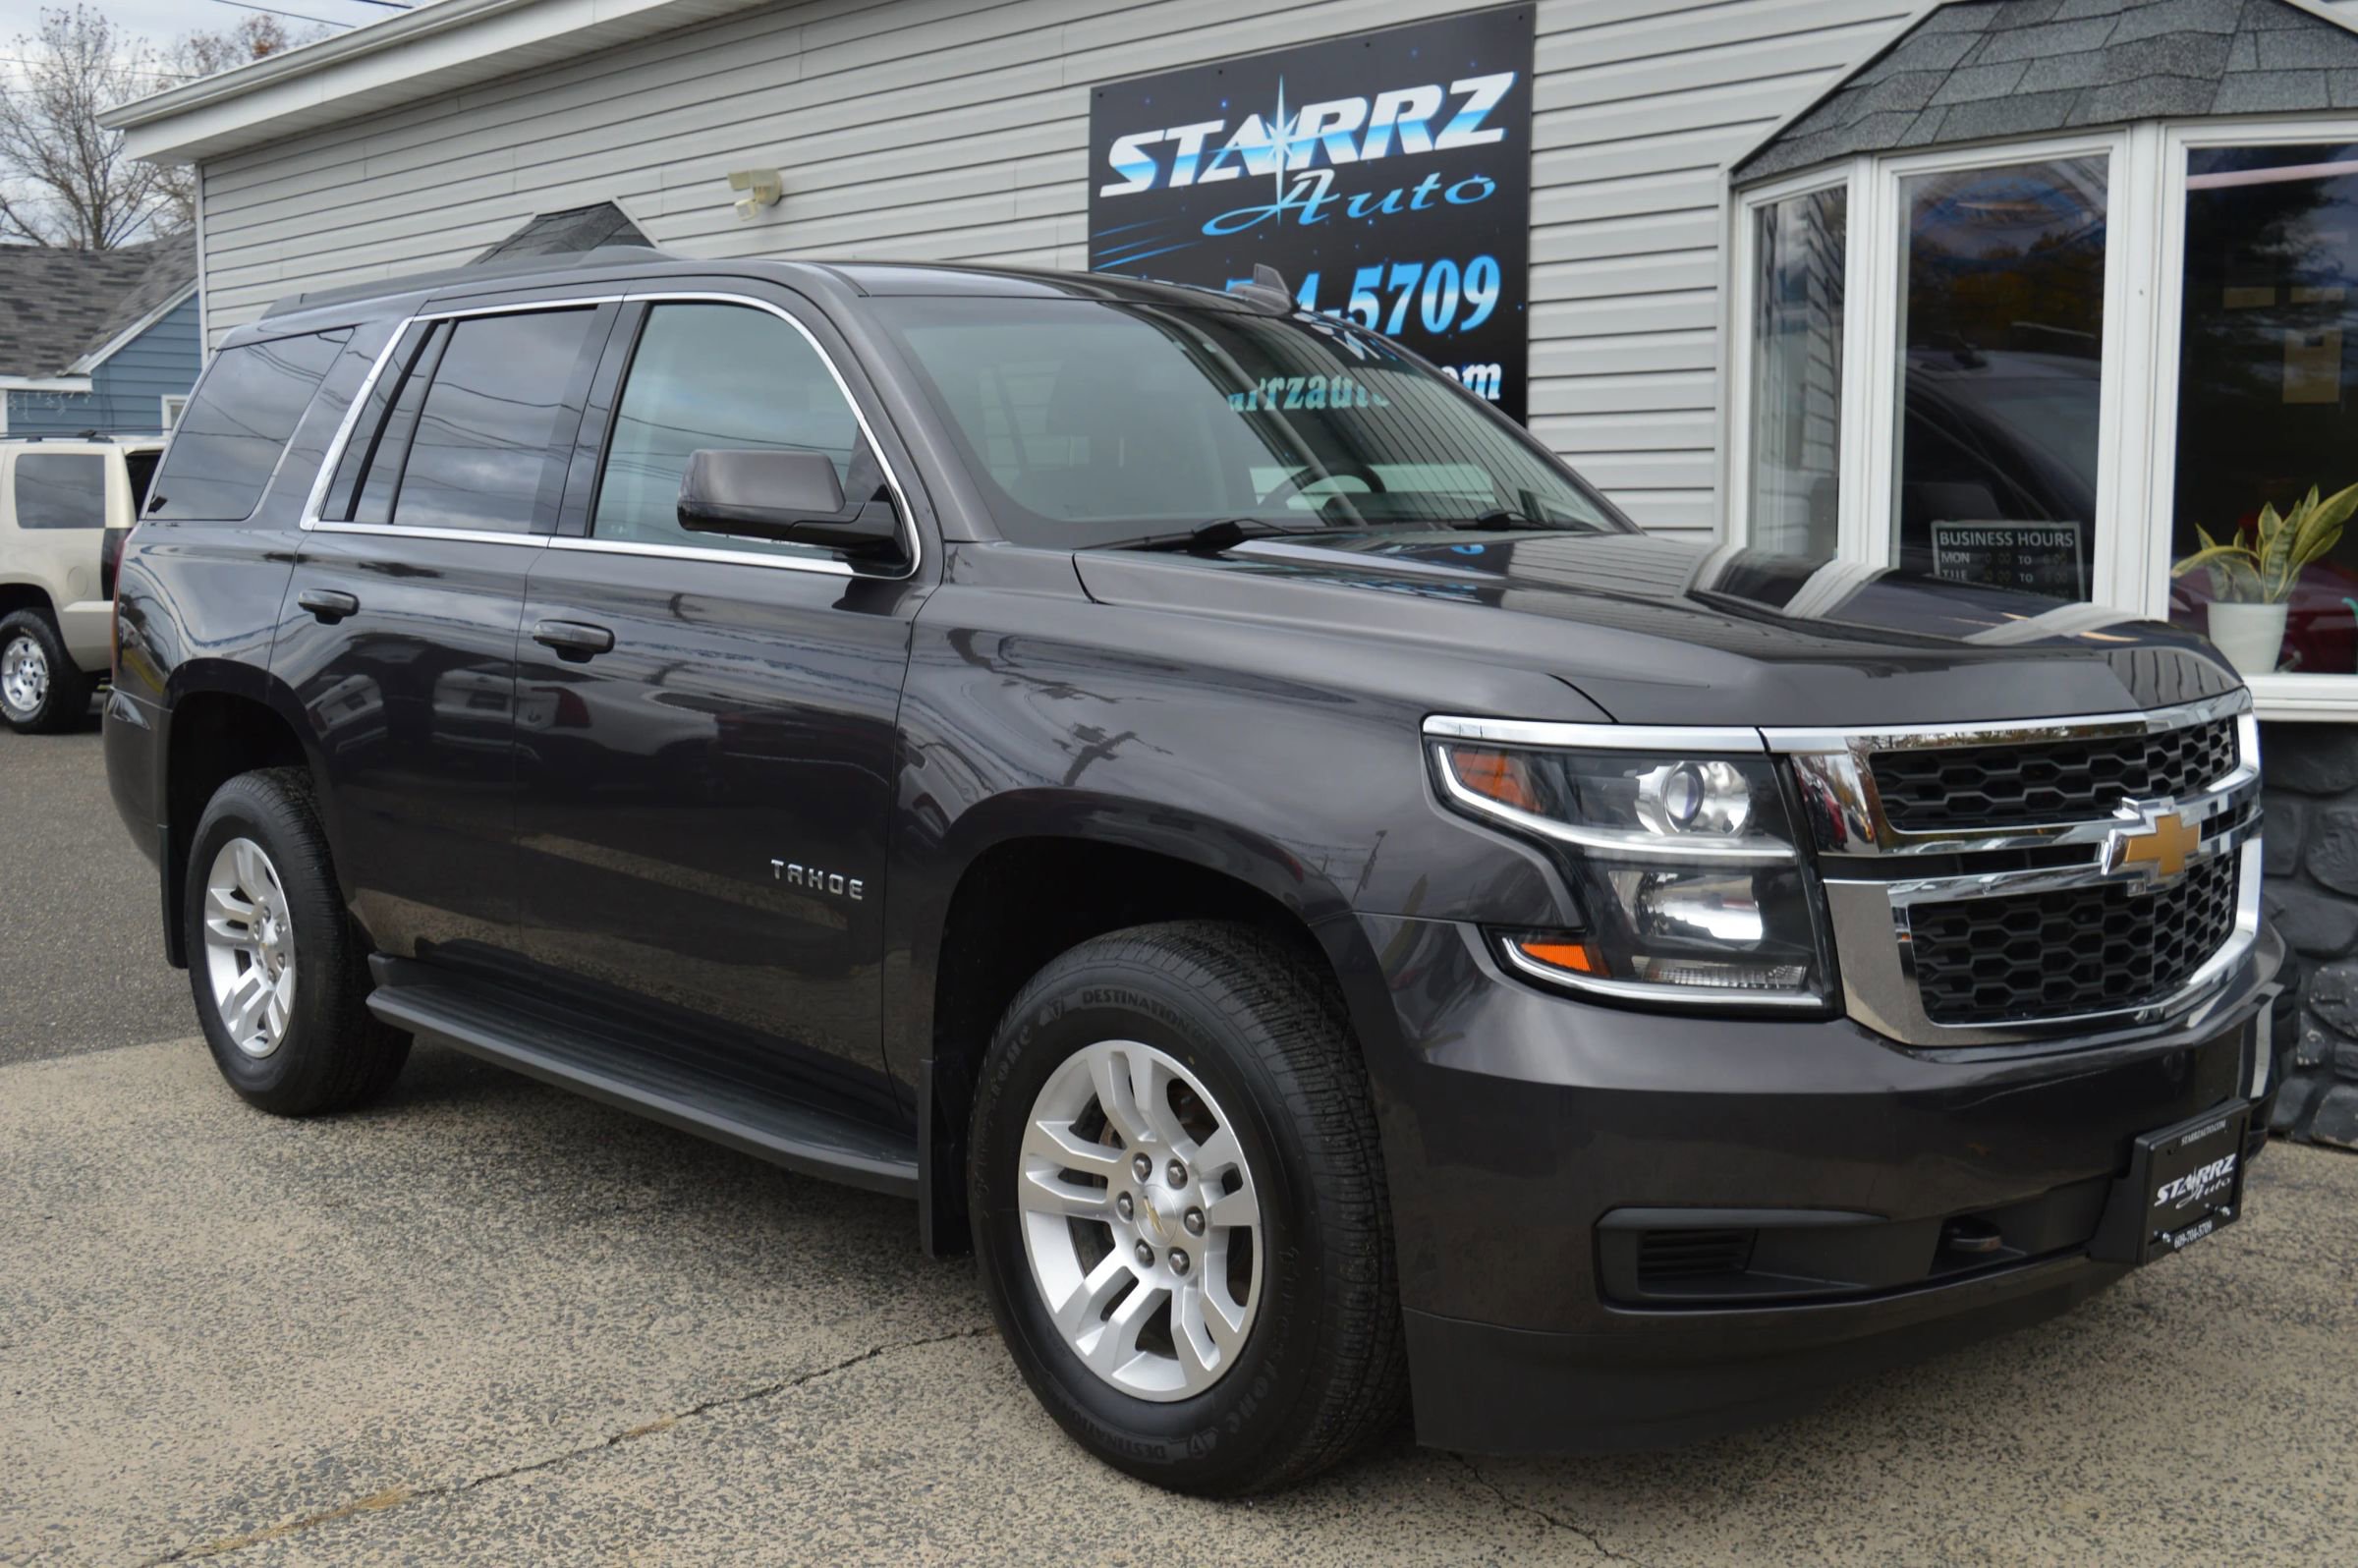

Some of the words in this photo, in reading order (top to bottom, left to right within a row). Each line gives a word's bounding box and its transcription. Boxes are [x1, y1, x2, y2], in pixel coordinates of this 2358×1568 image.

[1099, 71, 1519, 197] STARRZ
[1201, 168, 1496, 236] Auto
[1225, 254, 1501, 336] 4-5709
[1939, 531, 2013, 546] BUSINESS
[2017, 532, 2074, 547] HOURS
[1941, 552, 1970, 564] MON
[2017, 555, 2032, 566] TO
[2019, 573, 2034, 584] TO
[770, 859, 864, 901] TAHOE
[1082, 988, 1190, 1033] DESTINATION
[2154, 1152, 2237, 1206] STARRZ
[2175, 1177, 2231, 1209] Auto
